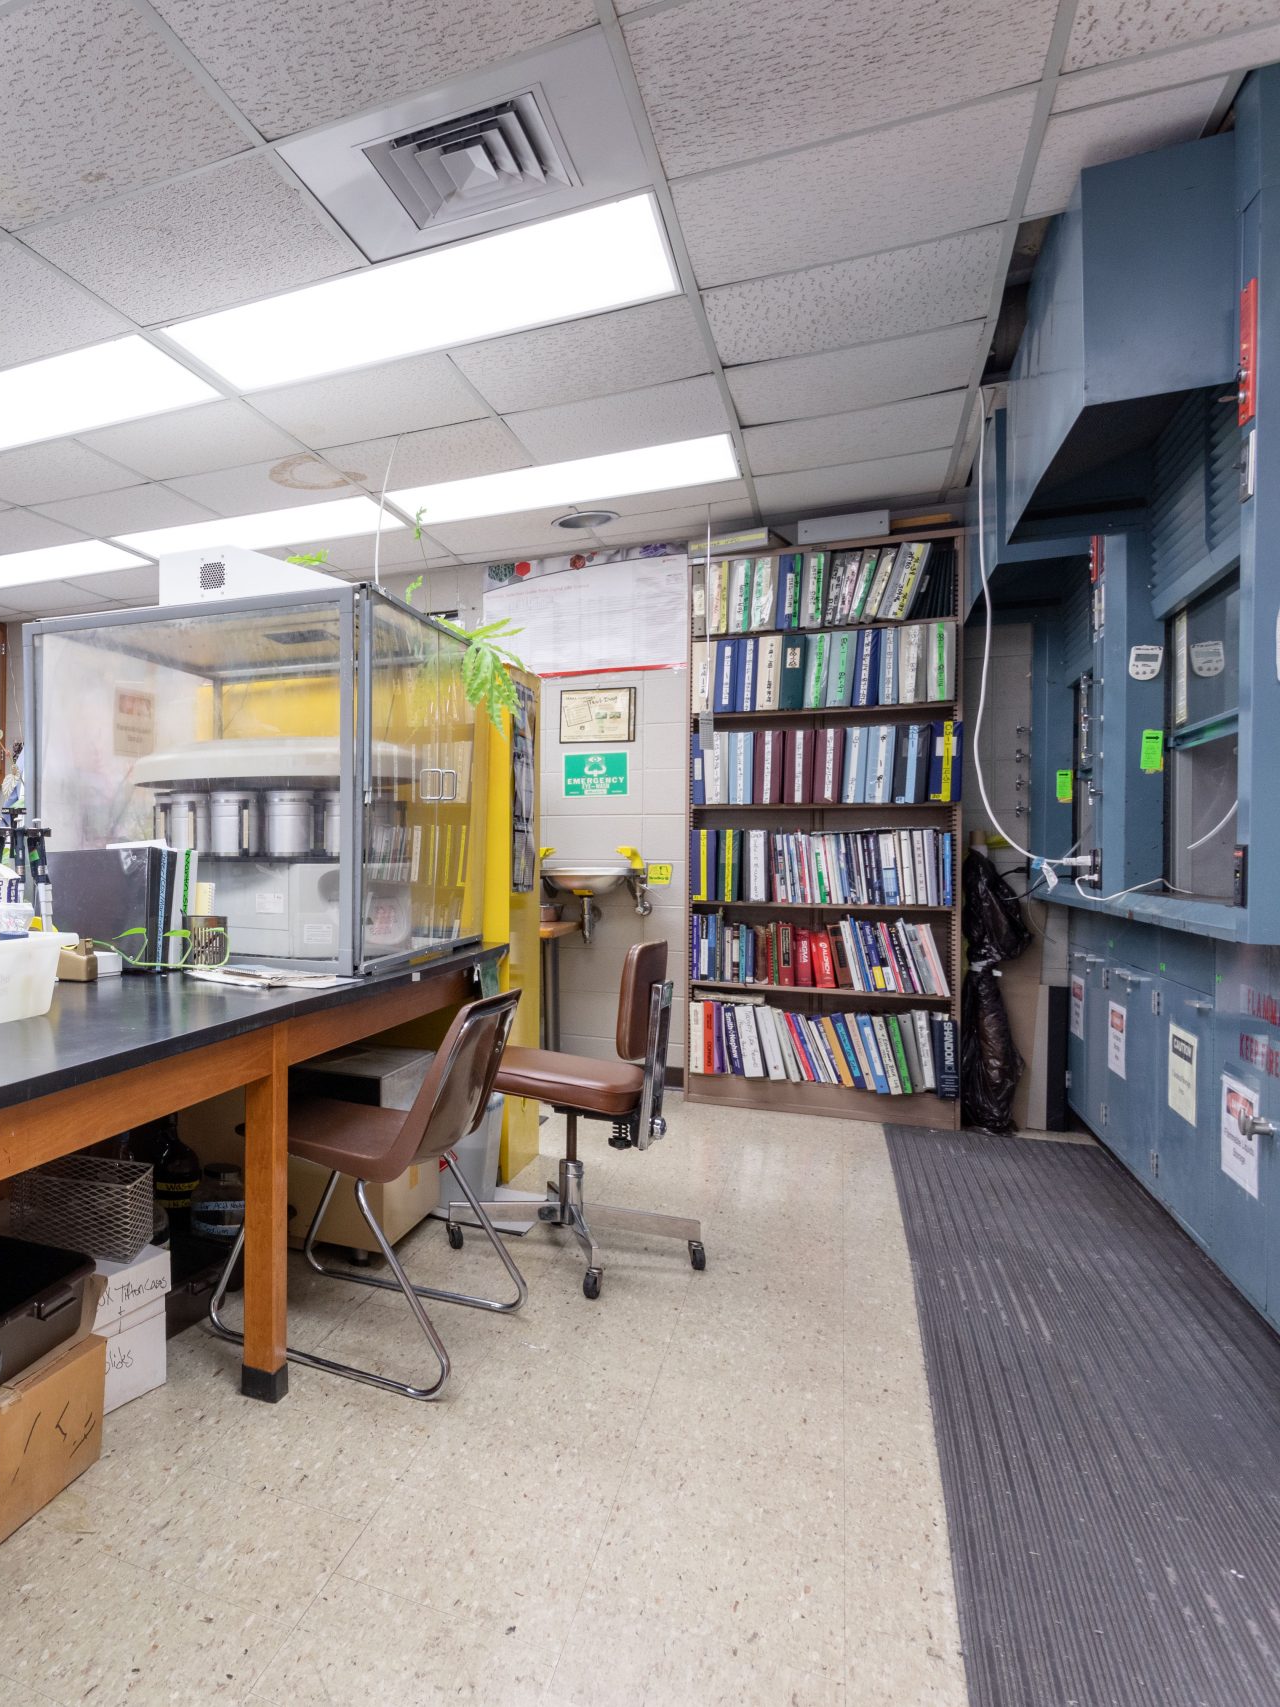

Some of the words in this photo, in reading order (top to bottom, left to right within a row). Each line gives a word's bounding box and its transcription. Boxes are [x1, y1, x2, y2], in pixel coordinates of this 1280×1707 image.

[567, 776, 625, 785] EMERGENCY
[801, 940, 809, 963] SIGMA
[821, 948, 831, 975] ALDRICH
[725, 1012, 734, 1030] Smith
[729, 1034, 739, 1059] Nephew
[943, 1021, 955, 1065] SHANDON
